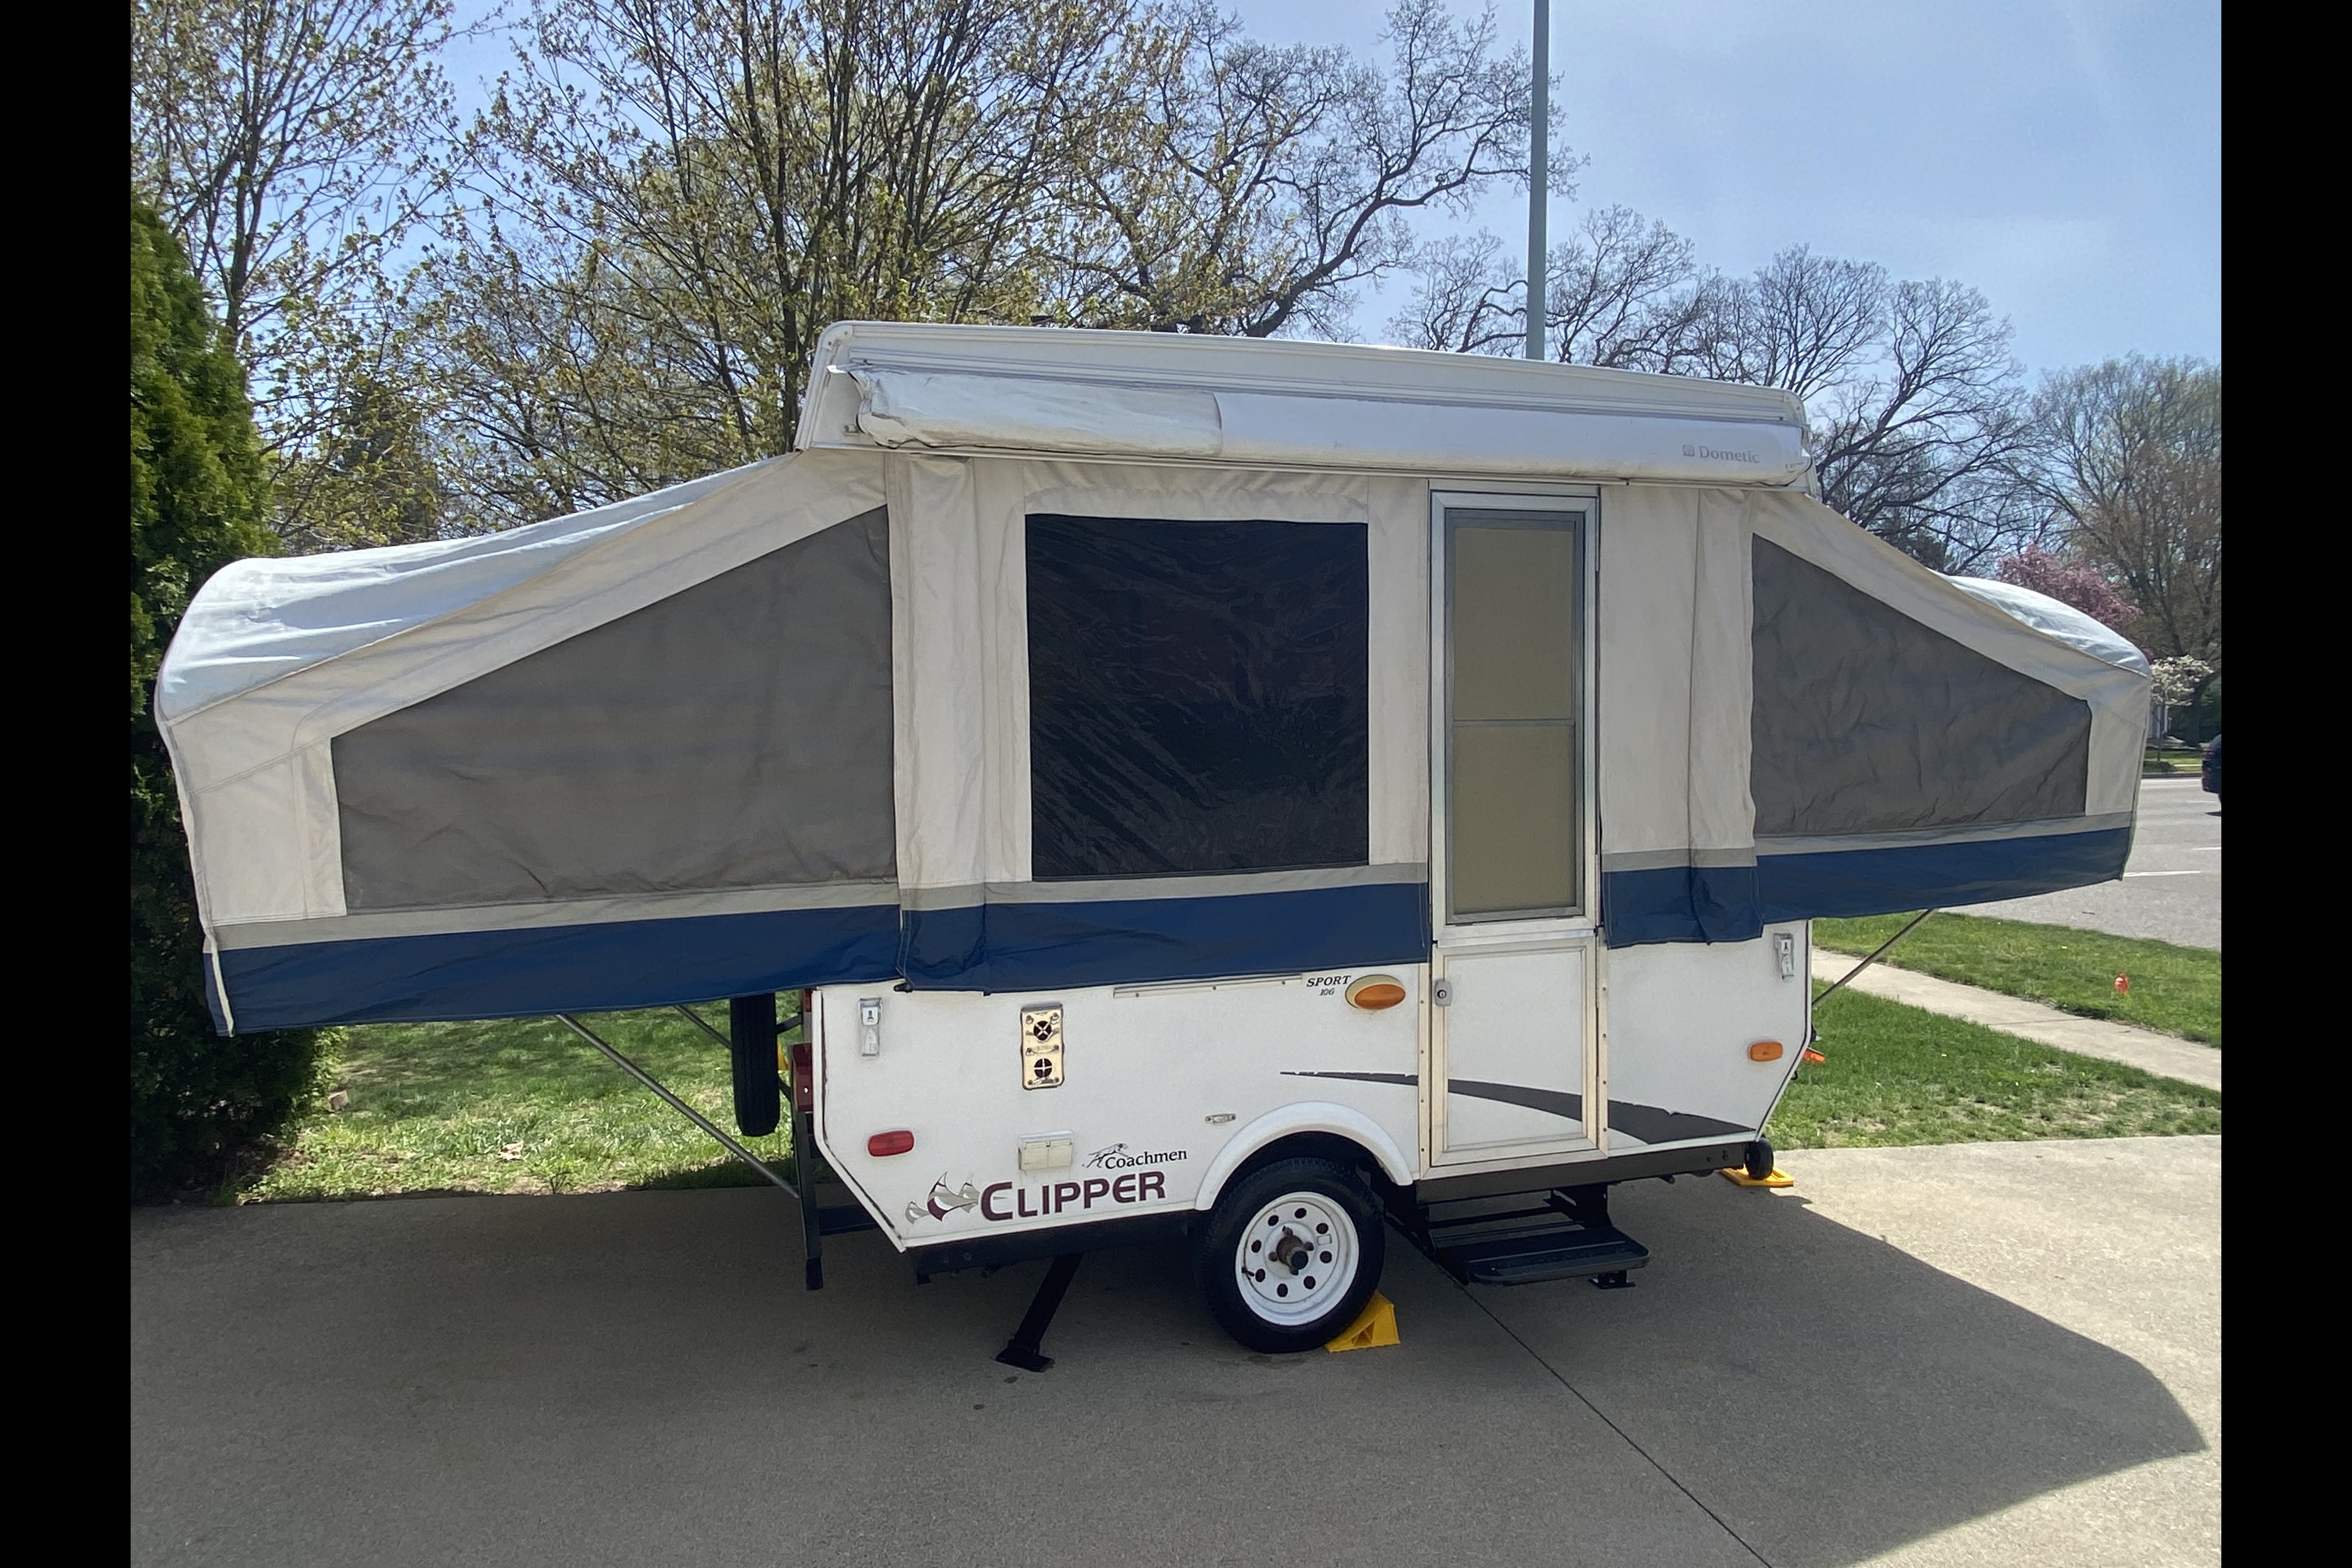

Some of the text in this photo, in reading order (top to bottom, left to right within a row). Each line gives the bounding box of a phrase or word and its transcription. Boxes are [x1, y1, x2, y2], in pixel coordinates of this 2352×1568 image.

[1699, 445, 1760, 463] Dometic
[1306, 975, 1351, 987] SPORT
[1105, 1150, 1187, 1170] Coachmen
[981, 1171, 1166, 1221] CLIPPER
